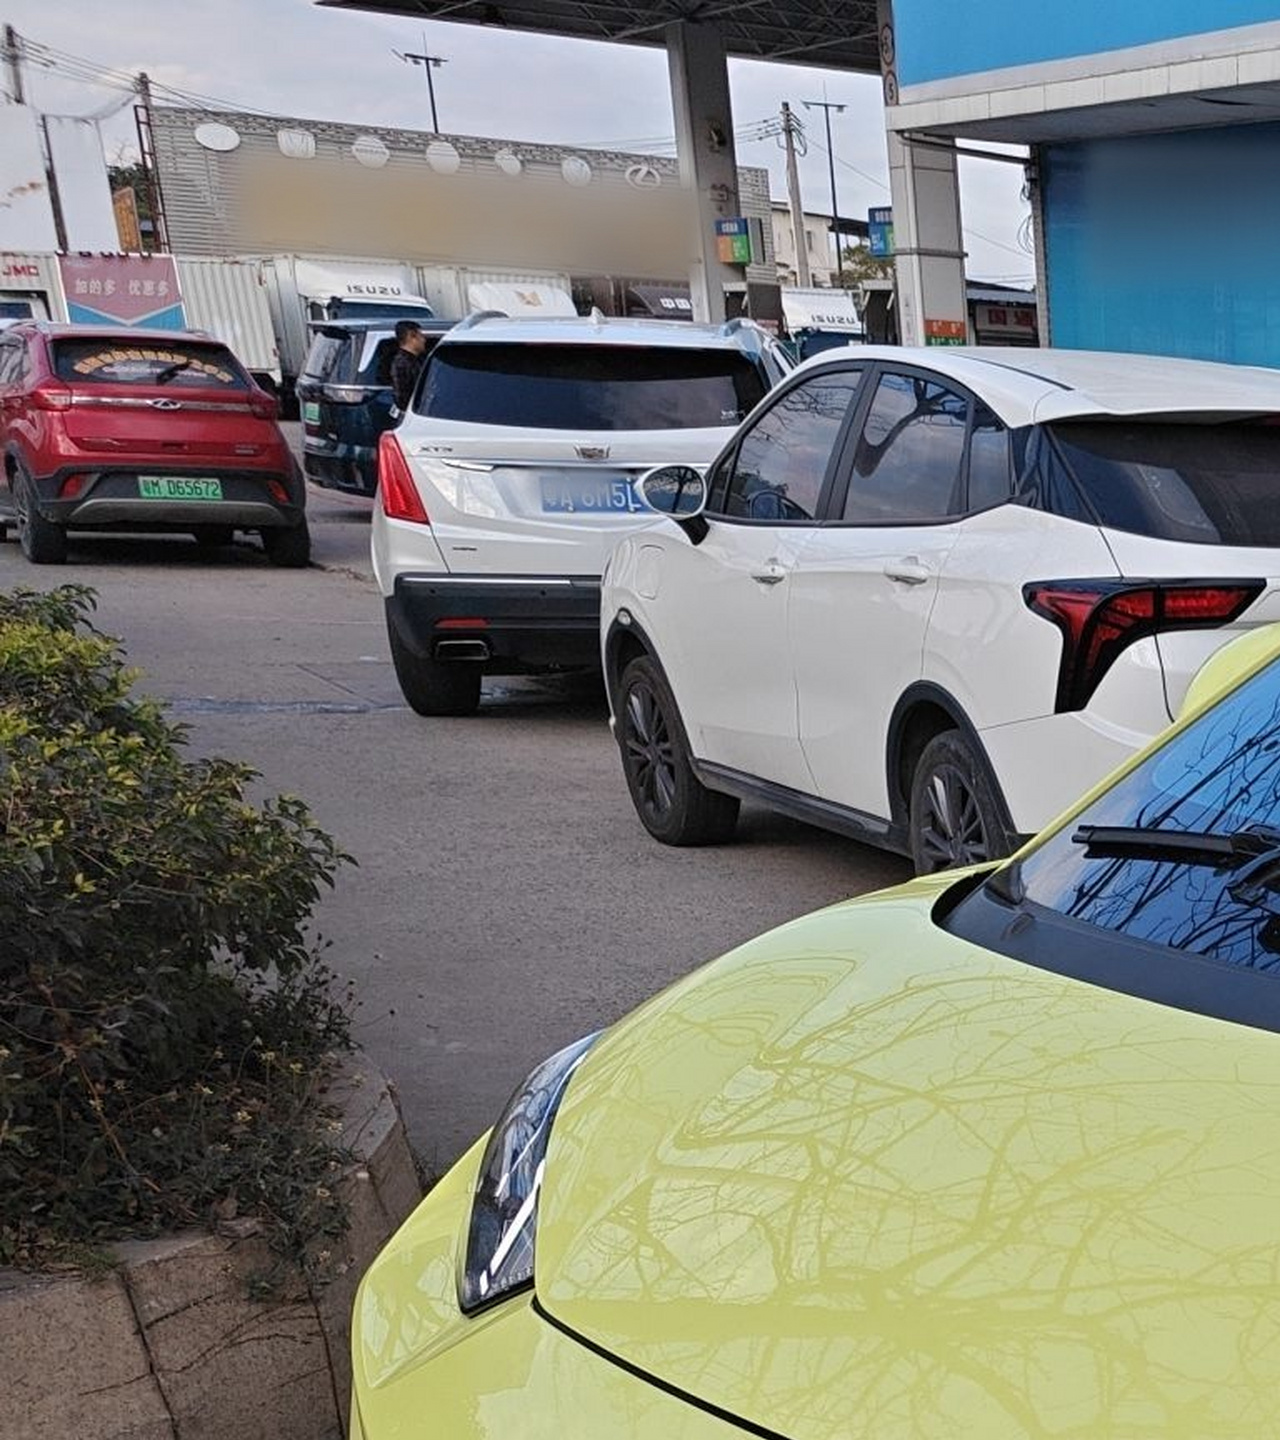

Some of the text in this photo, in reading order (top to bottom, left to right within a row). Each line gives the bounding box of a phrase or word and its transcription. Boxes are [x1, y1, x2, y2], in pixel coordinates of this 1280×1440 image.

[2, 264, 40, 277] JMC
[128, 279, 169, 297] 优惠多
[346, 284, 402, 296] ISUZU
[811, 314, 857, 325] ISUZU
[166, 479, 221, 497] D65672
[581, 483, 643, 508] 6M5L
